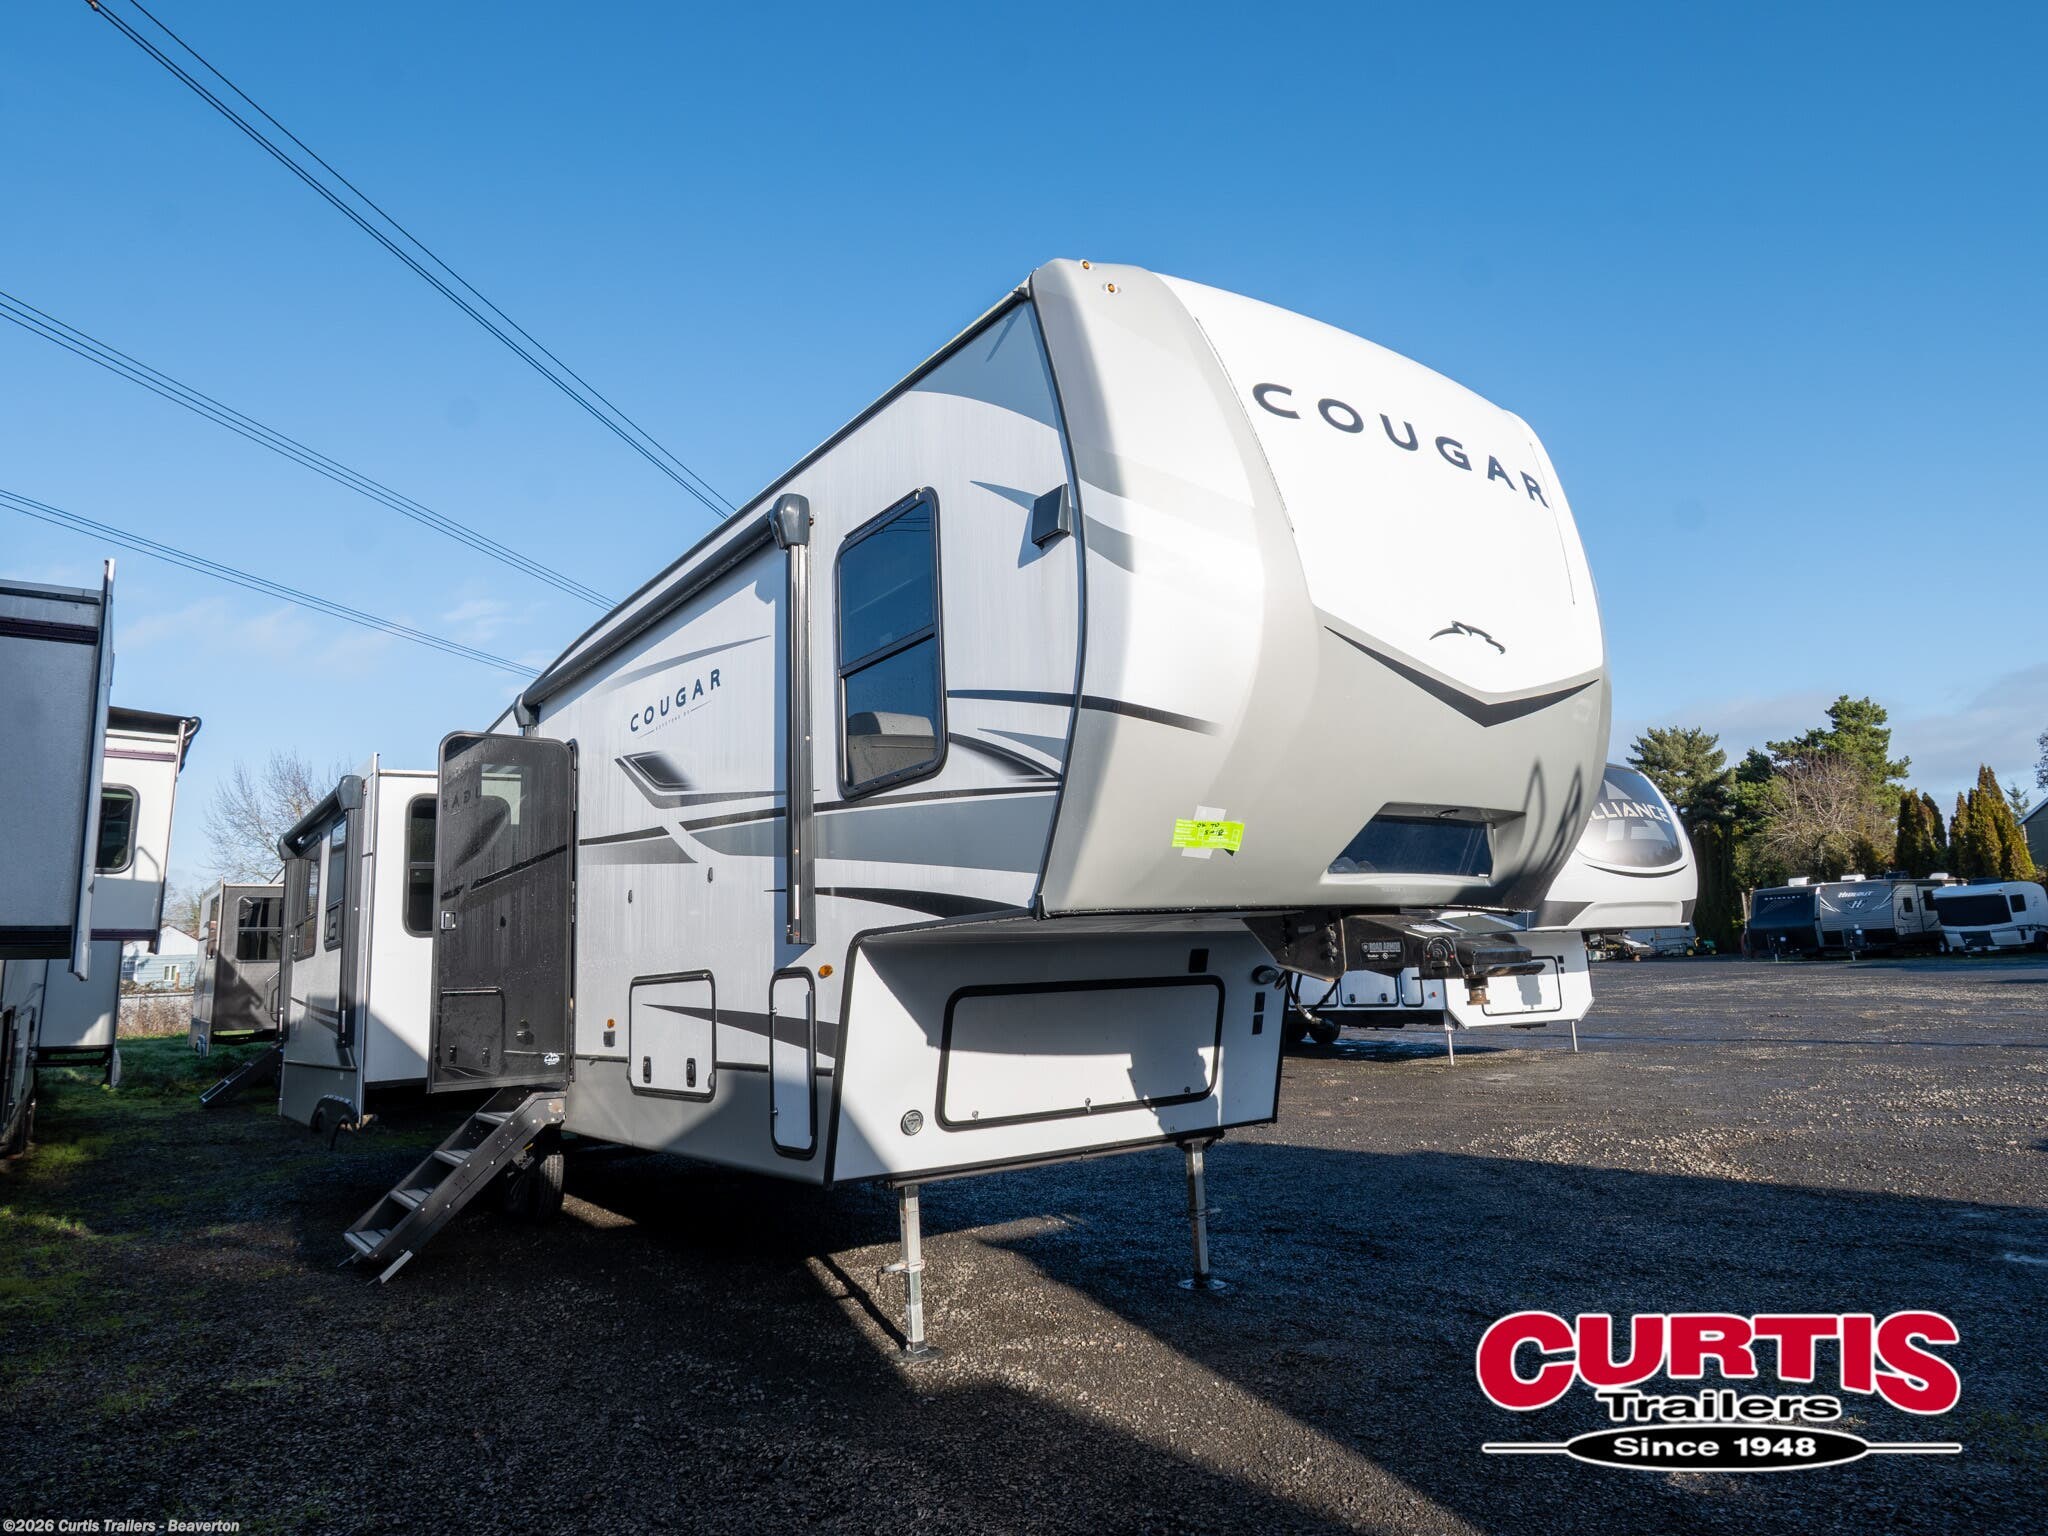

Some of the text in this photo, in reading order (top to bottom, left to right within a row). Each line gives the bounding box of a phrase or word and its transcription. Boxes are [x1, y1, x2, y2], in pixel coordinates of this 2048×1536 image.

[1252, 382, 1550, 509] COUGAR
[630, 668, 721, 732] COUGAR
[1591, 802, 1671, 824] LLIANCE
